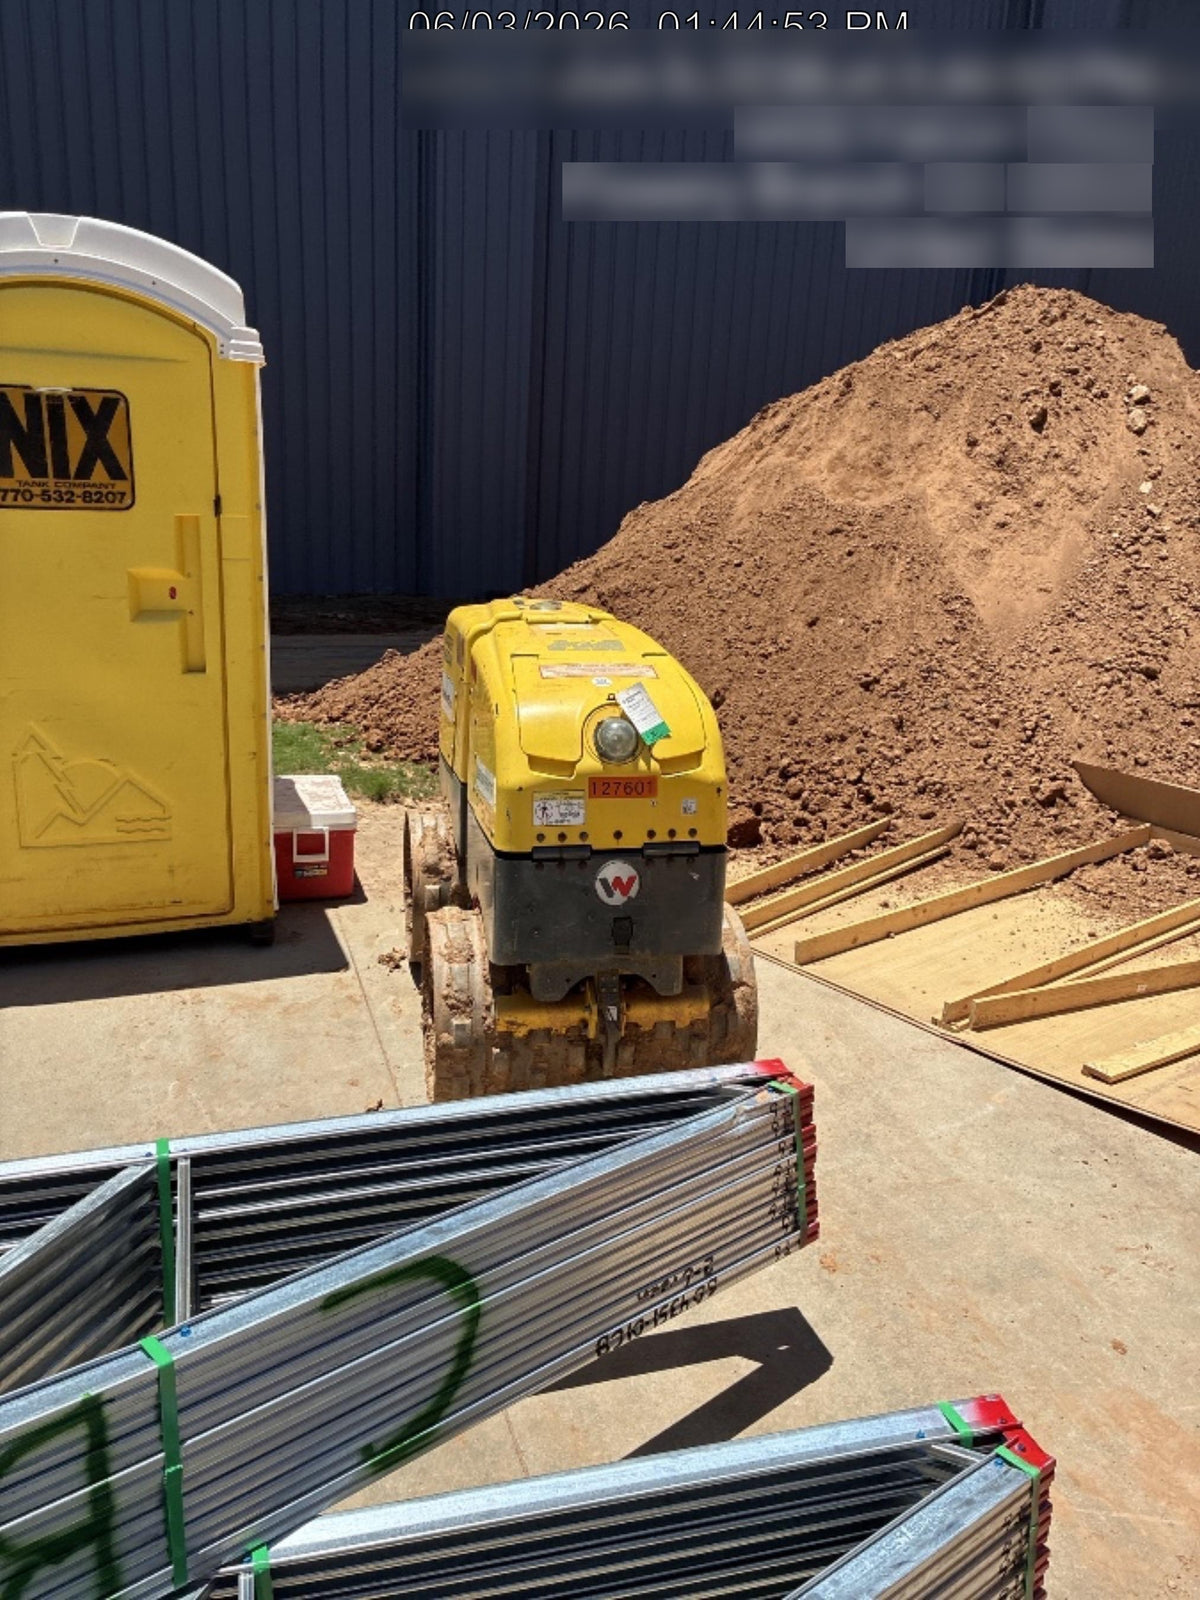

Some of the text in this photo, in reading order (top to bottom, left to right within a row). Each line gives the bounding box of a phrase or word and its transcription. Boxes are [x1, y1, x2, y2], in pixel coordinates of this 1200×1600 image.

[0, 390, 129, 480] NIX
[17, 479, 49, 488] TANK
[0, 488, 127, 504] 770-532-8207
[591, 780, 655, 796] 127601
